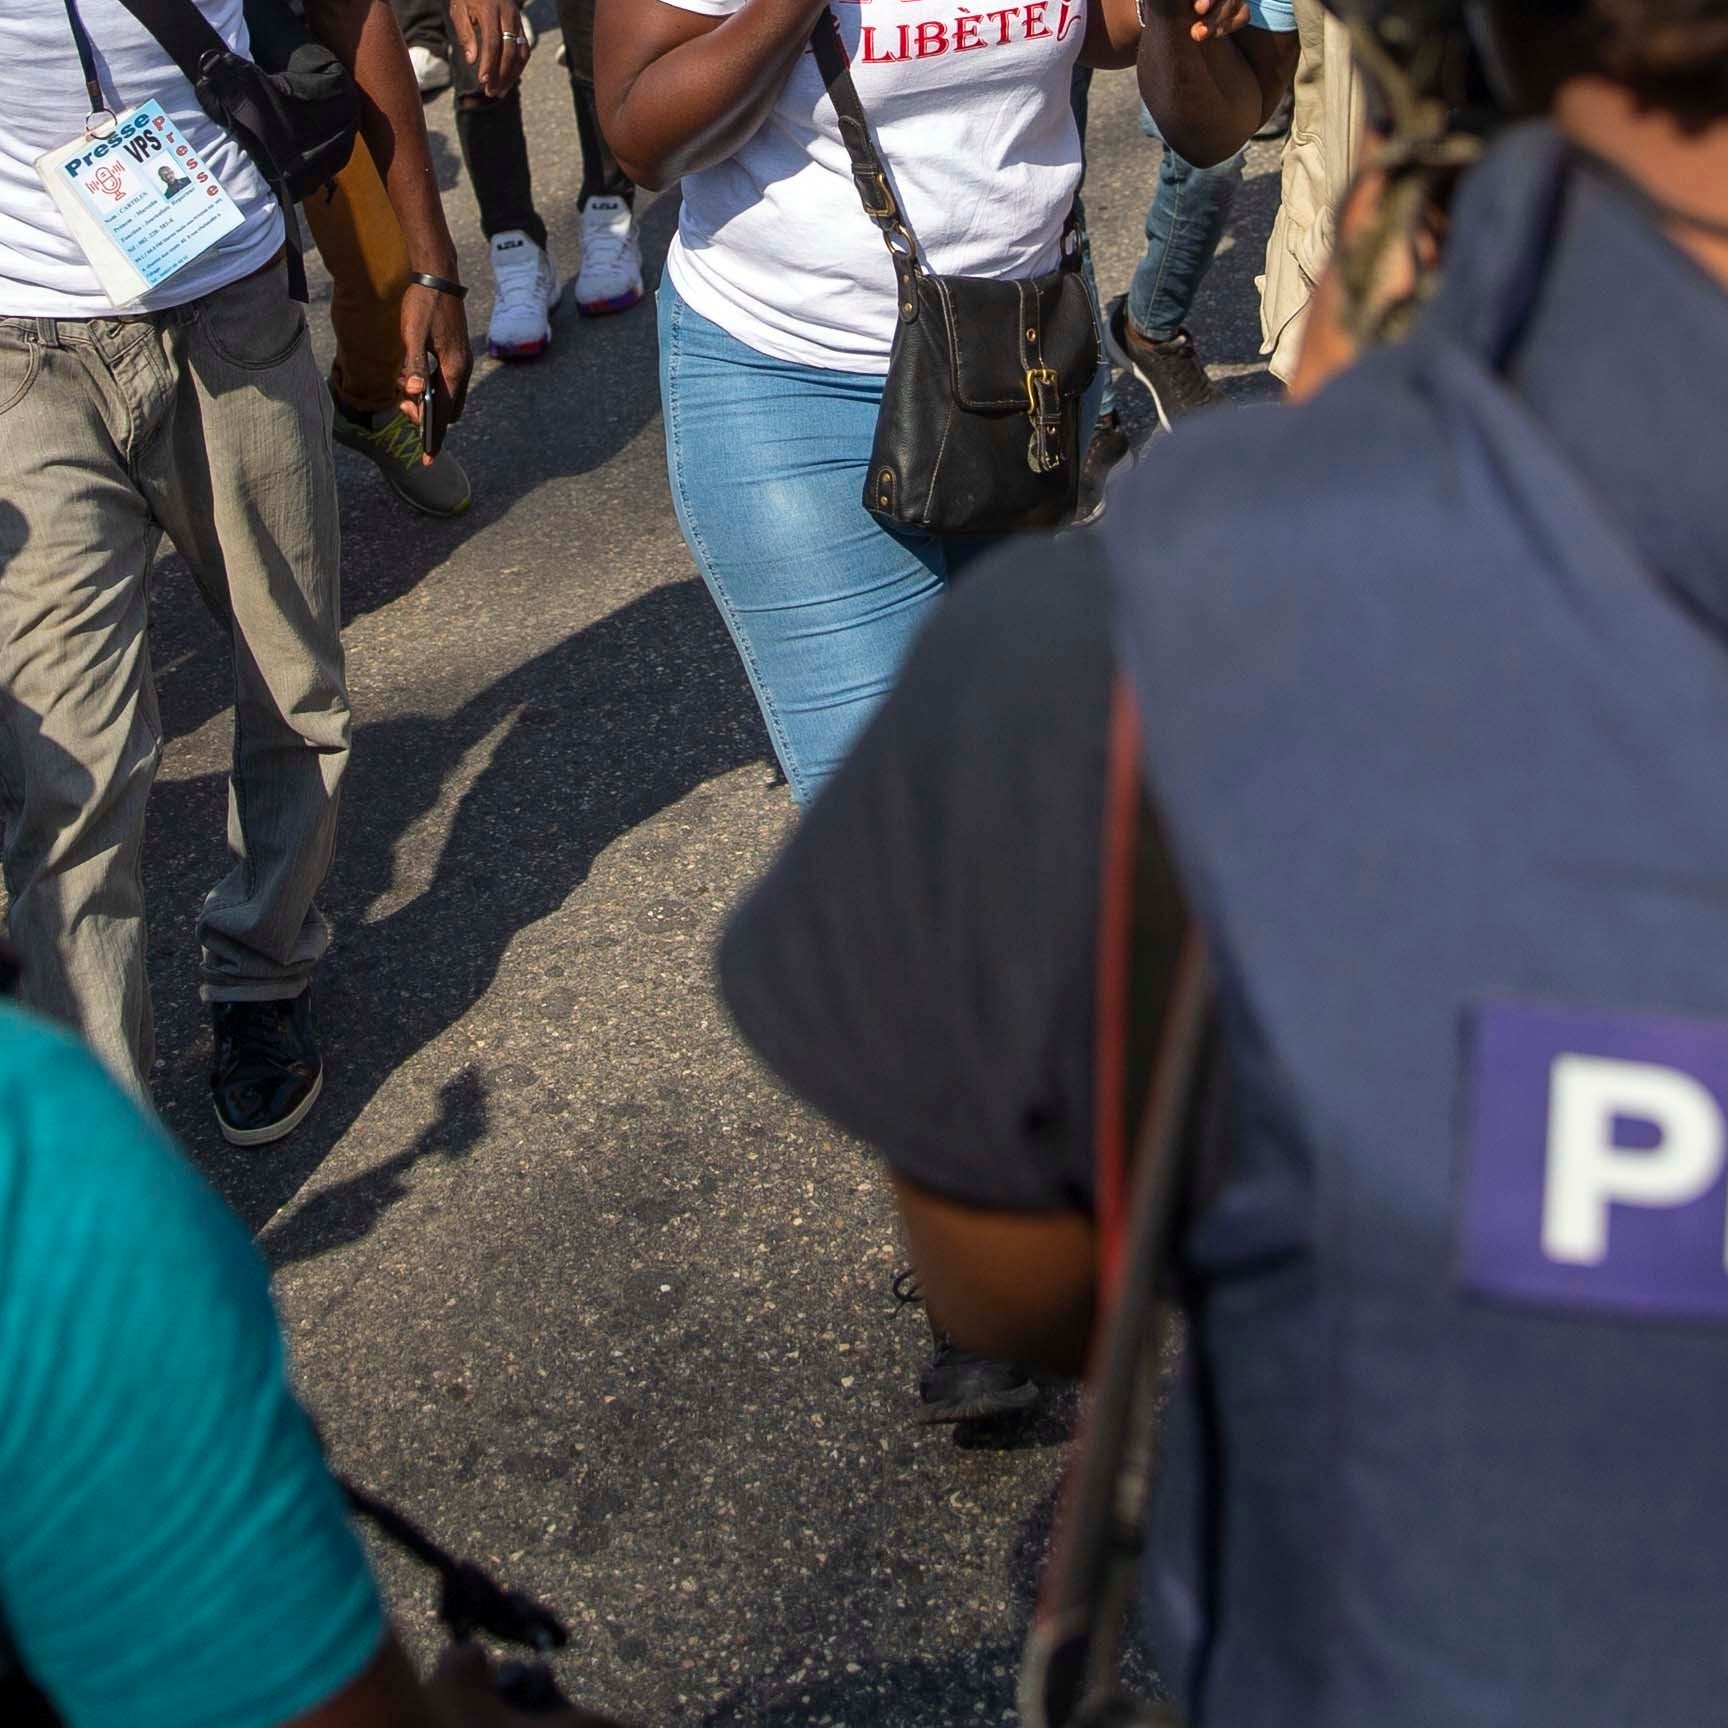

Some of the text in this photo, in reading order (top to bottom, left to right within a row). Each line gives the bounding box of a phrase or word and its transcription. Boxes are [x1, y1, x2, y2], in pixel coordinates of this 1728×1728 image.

[860, 0, 1052, 64] LIBÈTE
[64, 113, 150, 178] Presse
[123, 129, 162, 163] VPS
